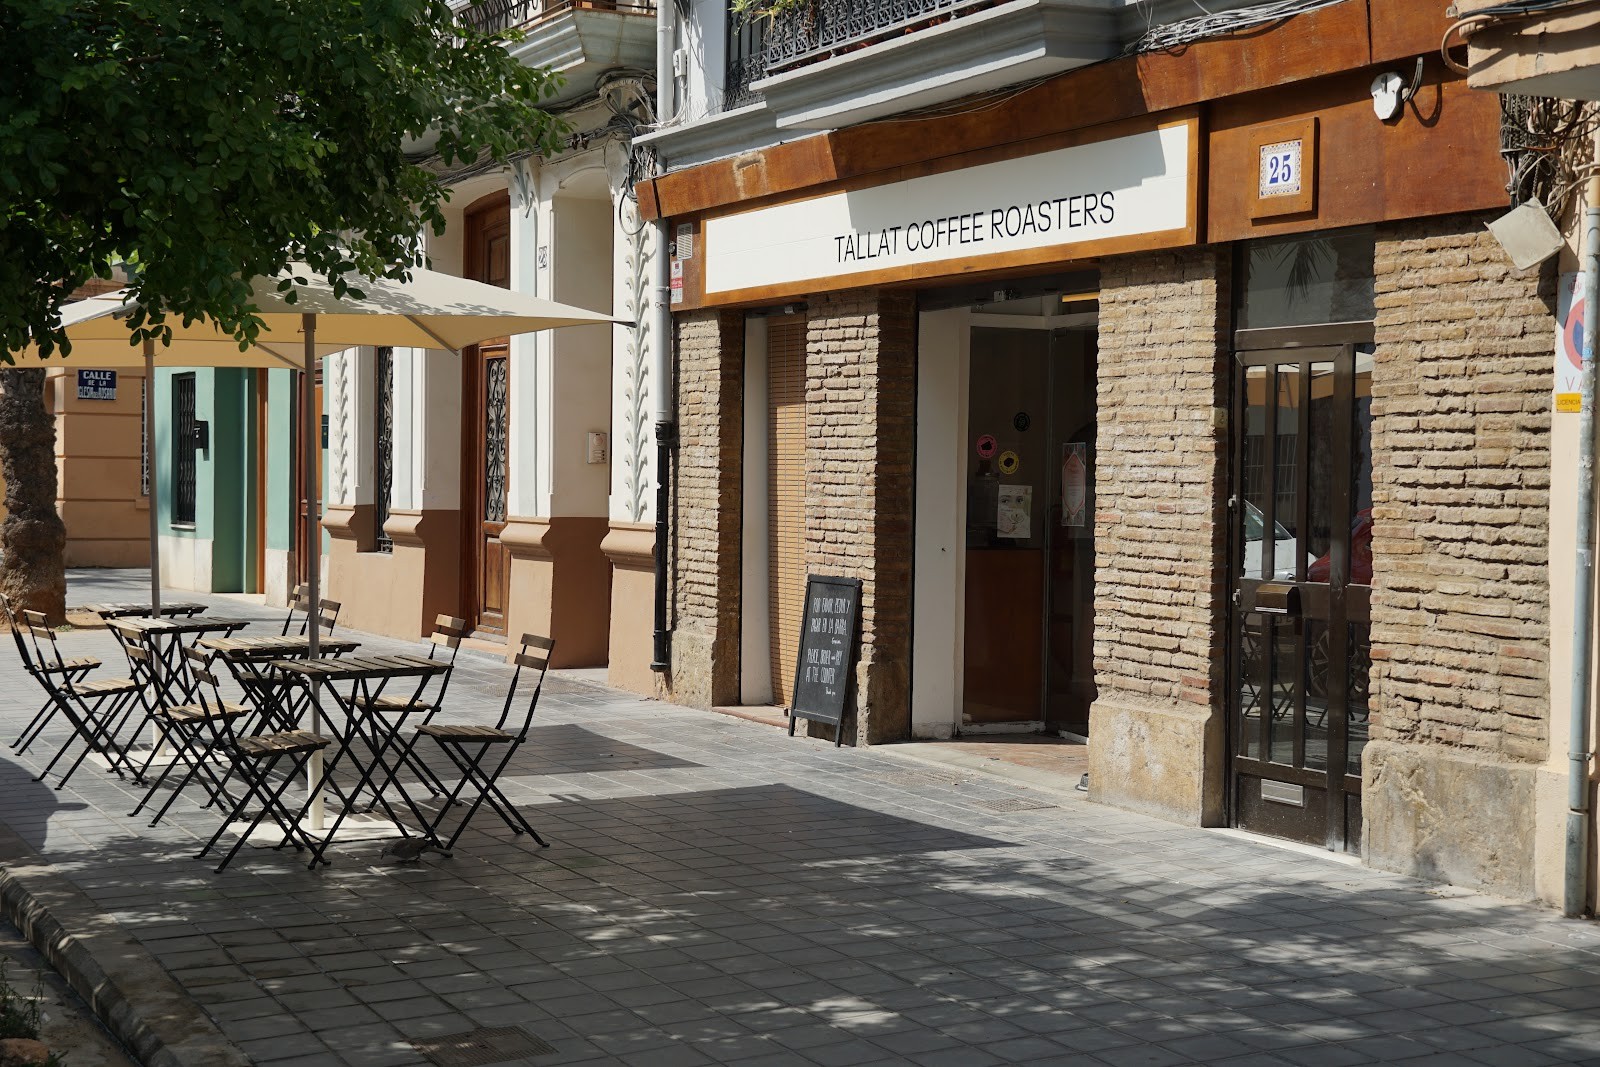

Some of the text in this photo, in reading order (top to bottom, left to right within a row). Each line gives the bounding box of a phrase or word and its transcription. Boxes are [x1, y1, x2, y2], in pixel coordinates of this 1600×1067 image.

[1269, 154, 1291, 184] 25
[834, 191, 1115, 263] TALLAT COFFEE ROASTERS
[83, 371, 111, 380] CALLE
[821, 617, 828, 633] EN
[827, 618, 834, 634] LA
[806, 666, 811, 683] AT
[811, 666, 819, 683] THE
